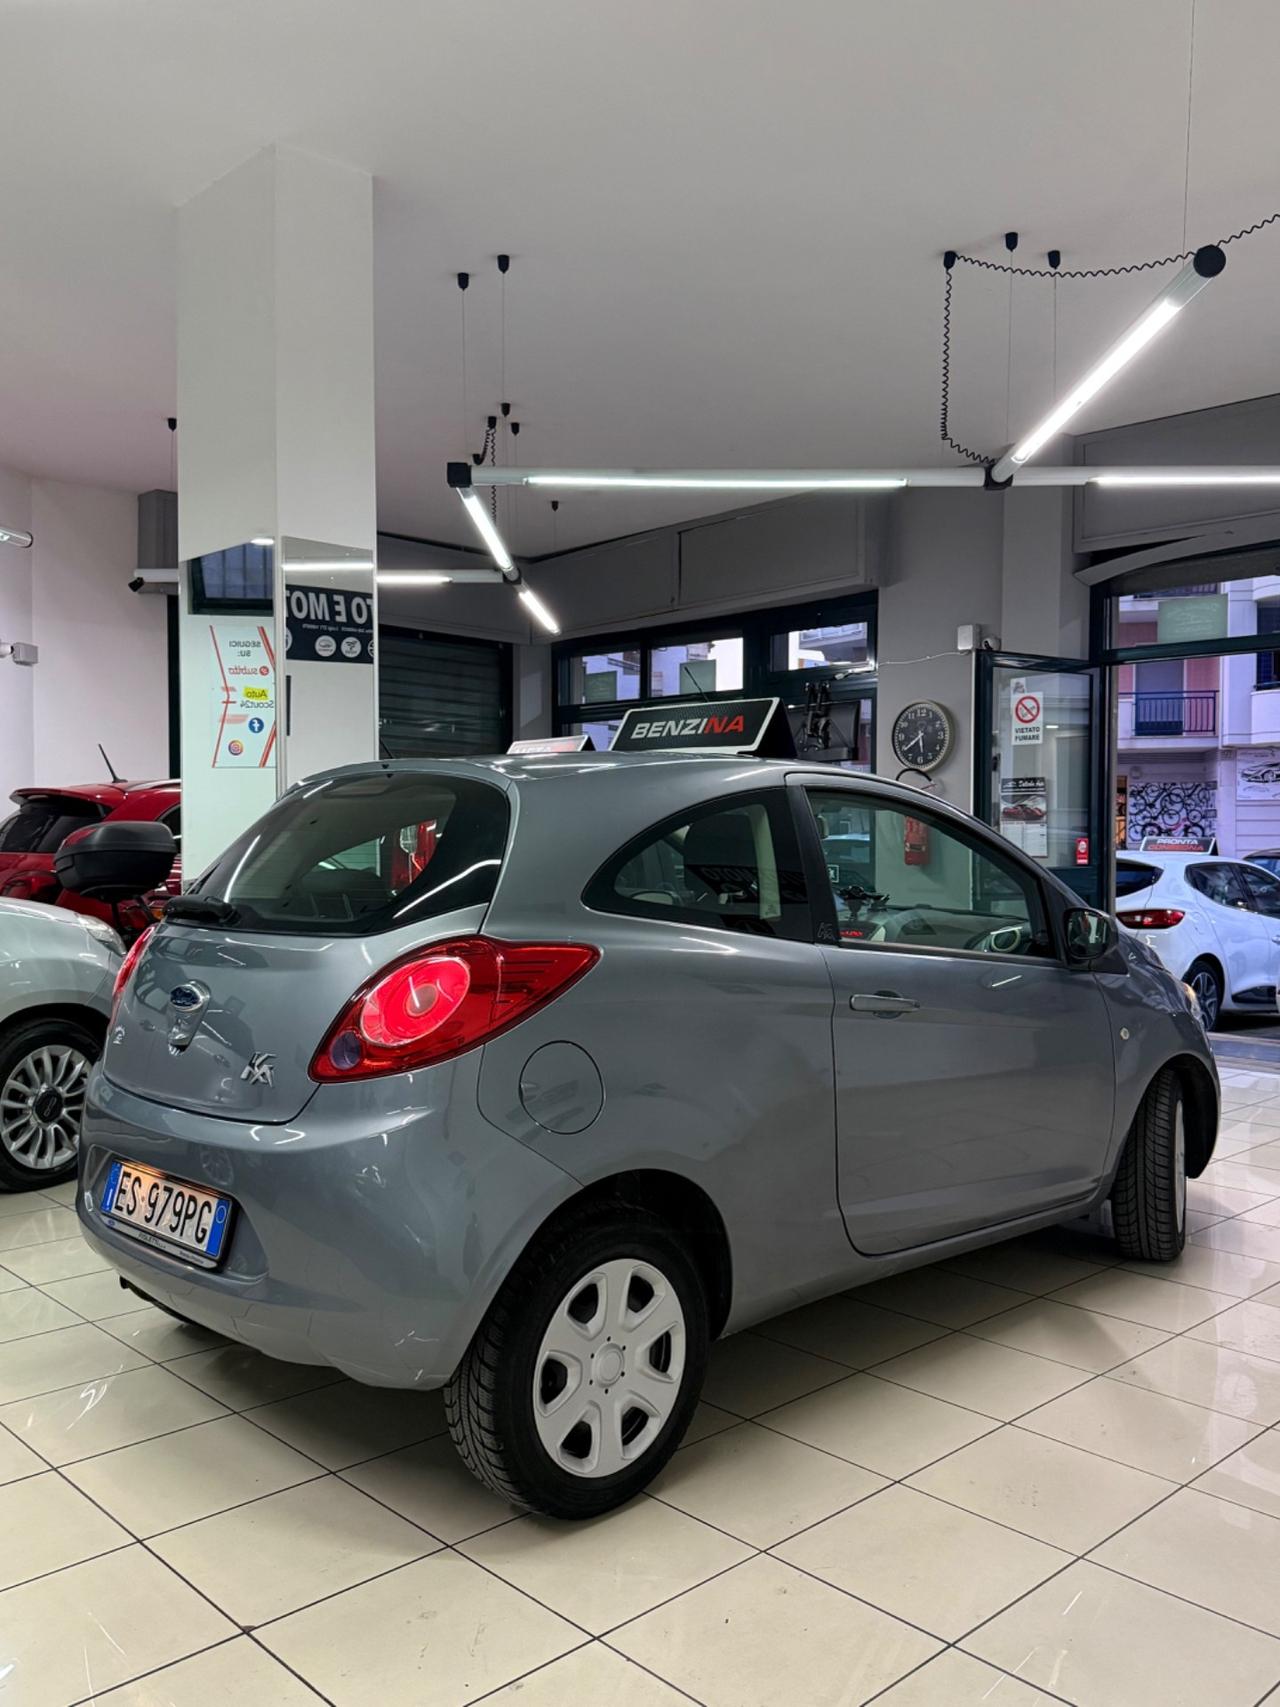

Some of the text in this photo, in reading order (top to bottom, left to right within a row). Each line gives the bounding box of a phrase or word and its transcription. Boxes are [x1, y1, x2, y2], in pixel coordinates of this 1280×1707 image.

[630, 714, 745, 739] BENZINA
[1014, 726, 1041, 734] VIETATO
[1014, 734, 1040, 742] FUMARE
